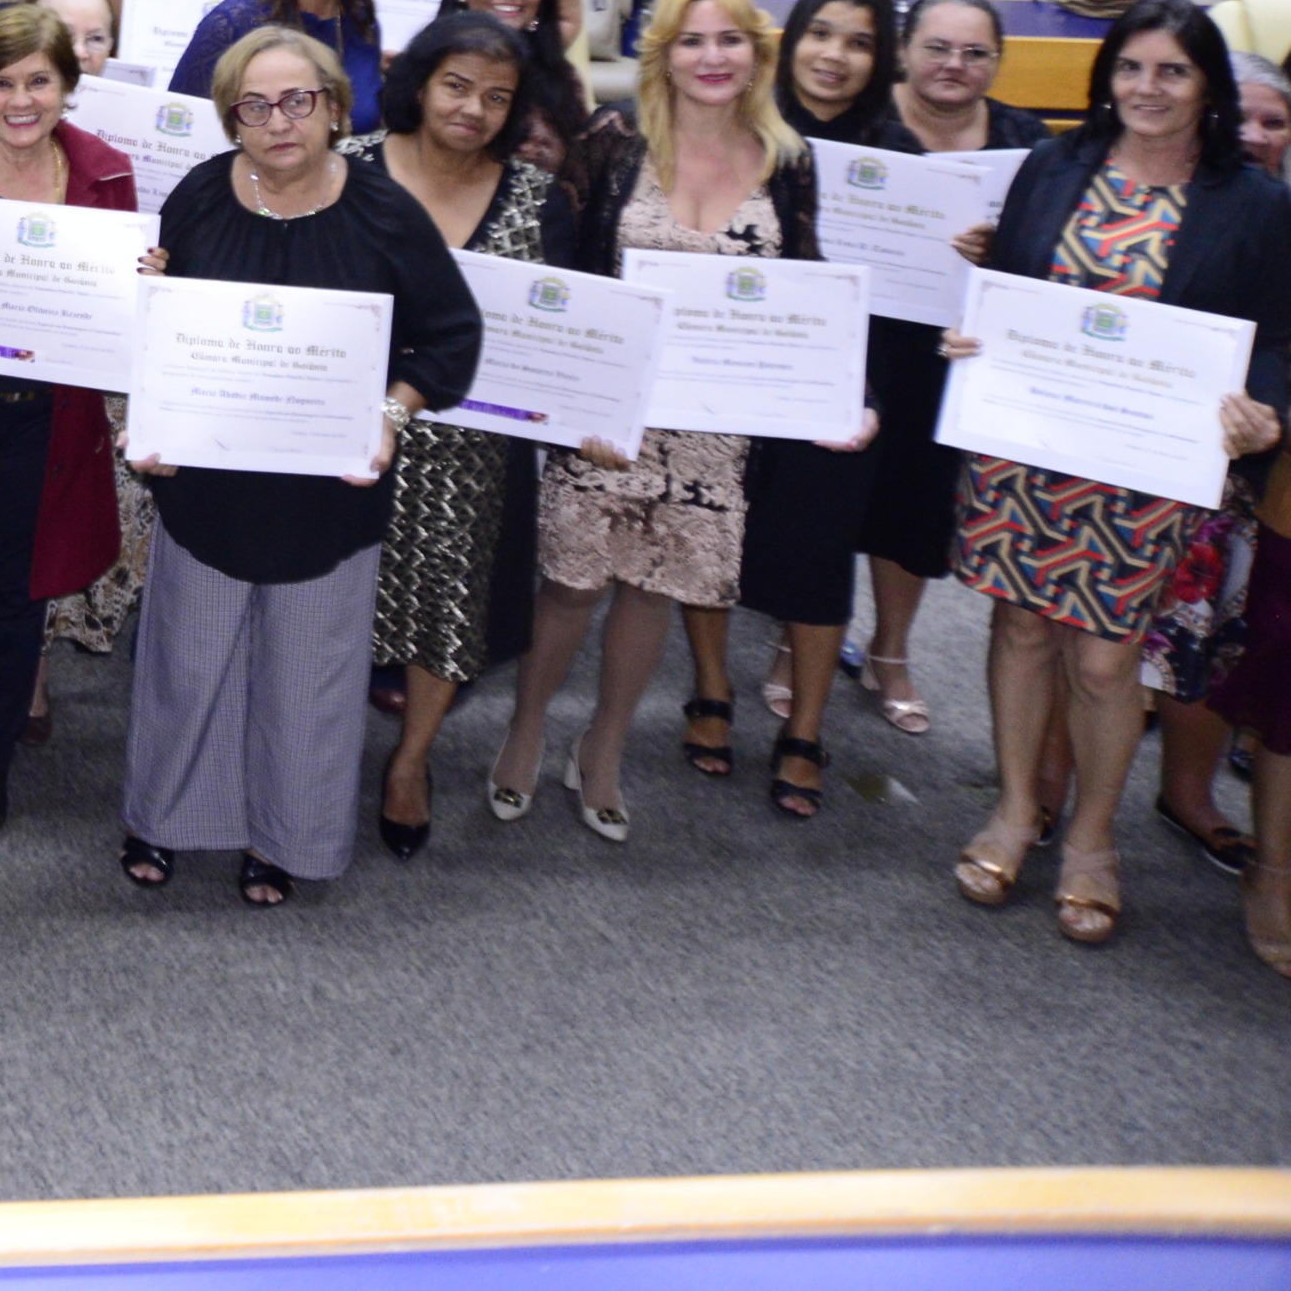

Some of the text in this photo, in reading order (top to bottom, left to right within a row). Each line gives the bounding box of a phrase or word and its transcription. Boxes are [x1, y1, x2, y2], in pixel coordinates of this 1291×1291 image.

[156, 141, 191, 157] Honra
[4, 252, 16, 264] de
[20, 254, 56, 269] Honra
[60, 261, 73, 270] ao
[77, 261, 115, 275] Mérito
